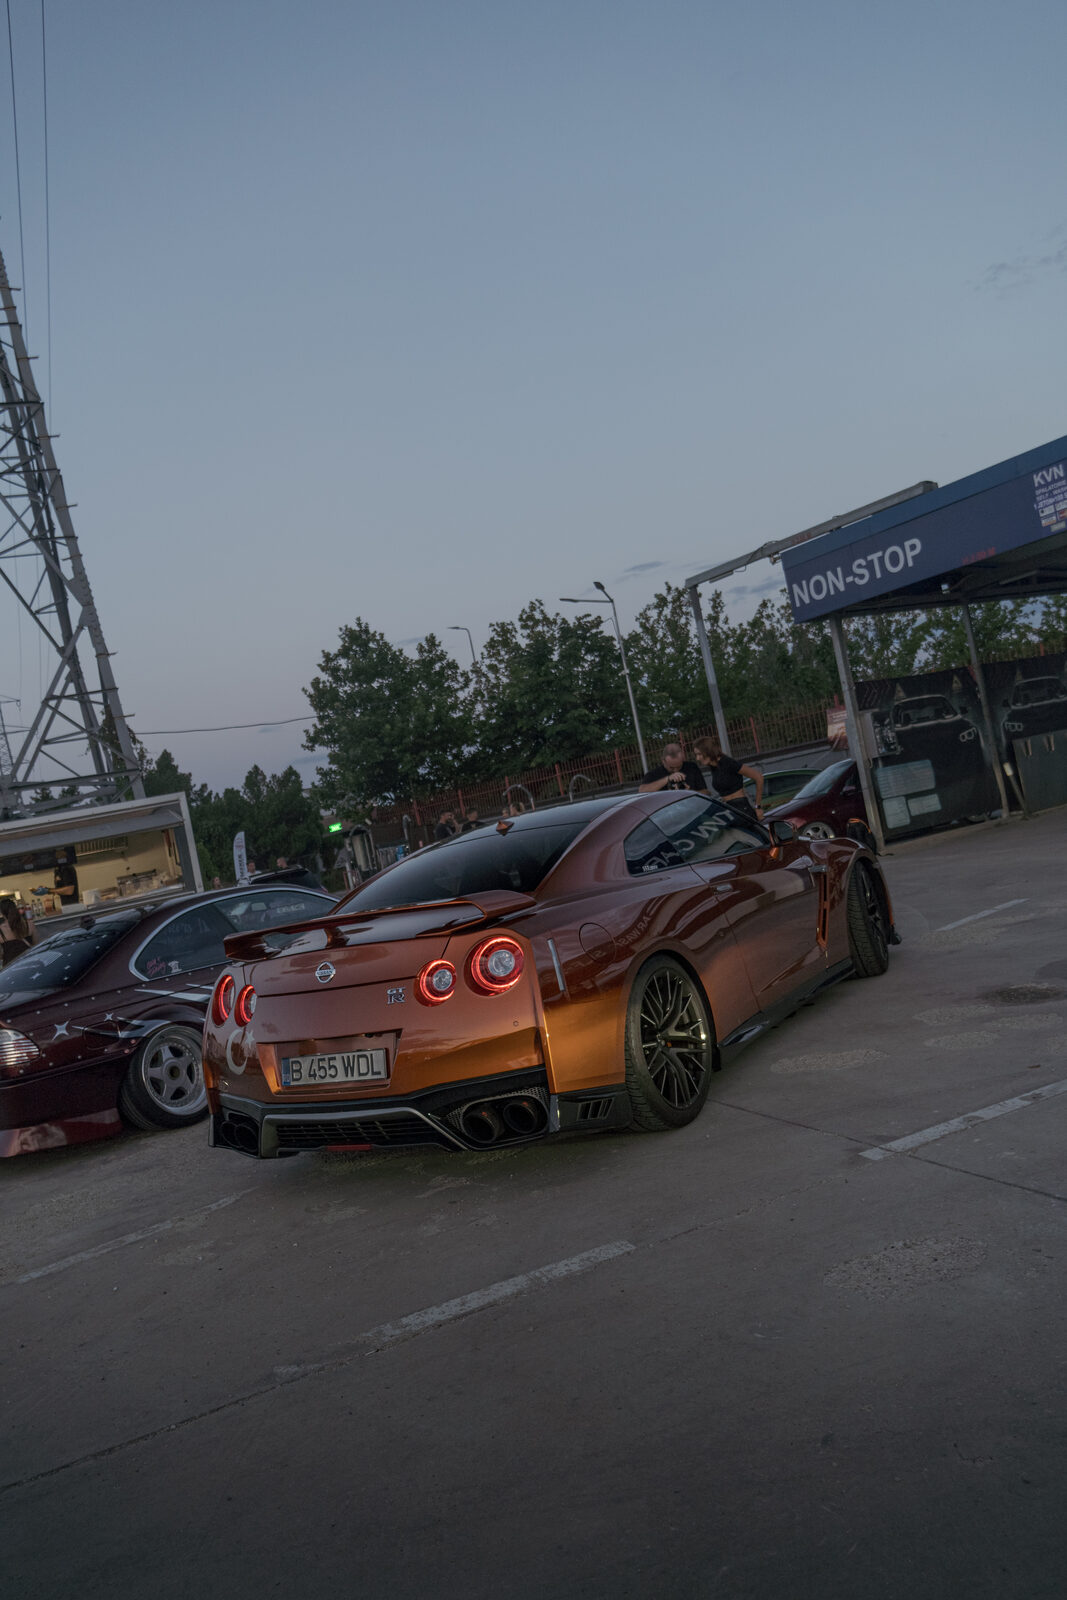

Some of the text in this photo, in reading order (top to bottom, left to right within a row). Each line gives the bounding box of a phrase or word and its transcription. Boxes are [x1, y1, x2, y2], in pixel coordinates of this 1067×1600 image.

[1033, 464, 1065, 487] KVN
[791, 538, 922, 608] NON-STOP
[291, 1060, 302, 1082] B
[308, 1056, 338, 1080] 455
[342, 1053, 381, 1078] WDL
